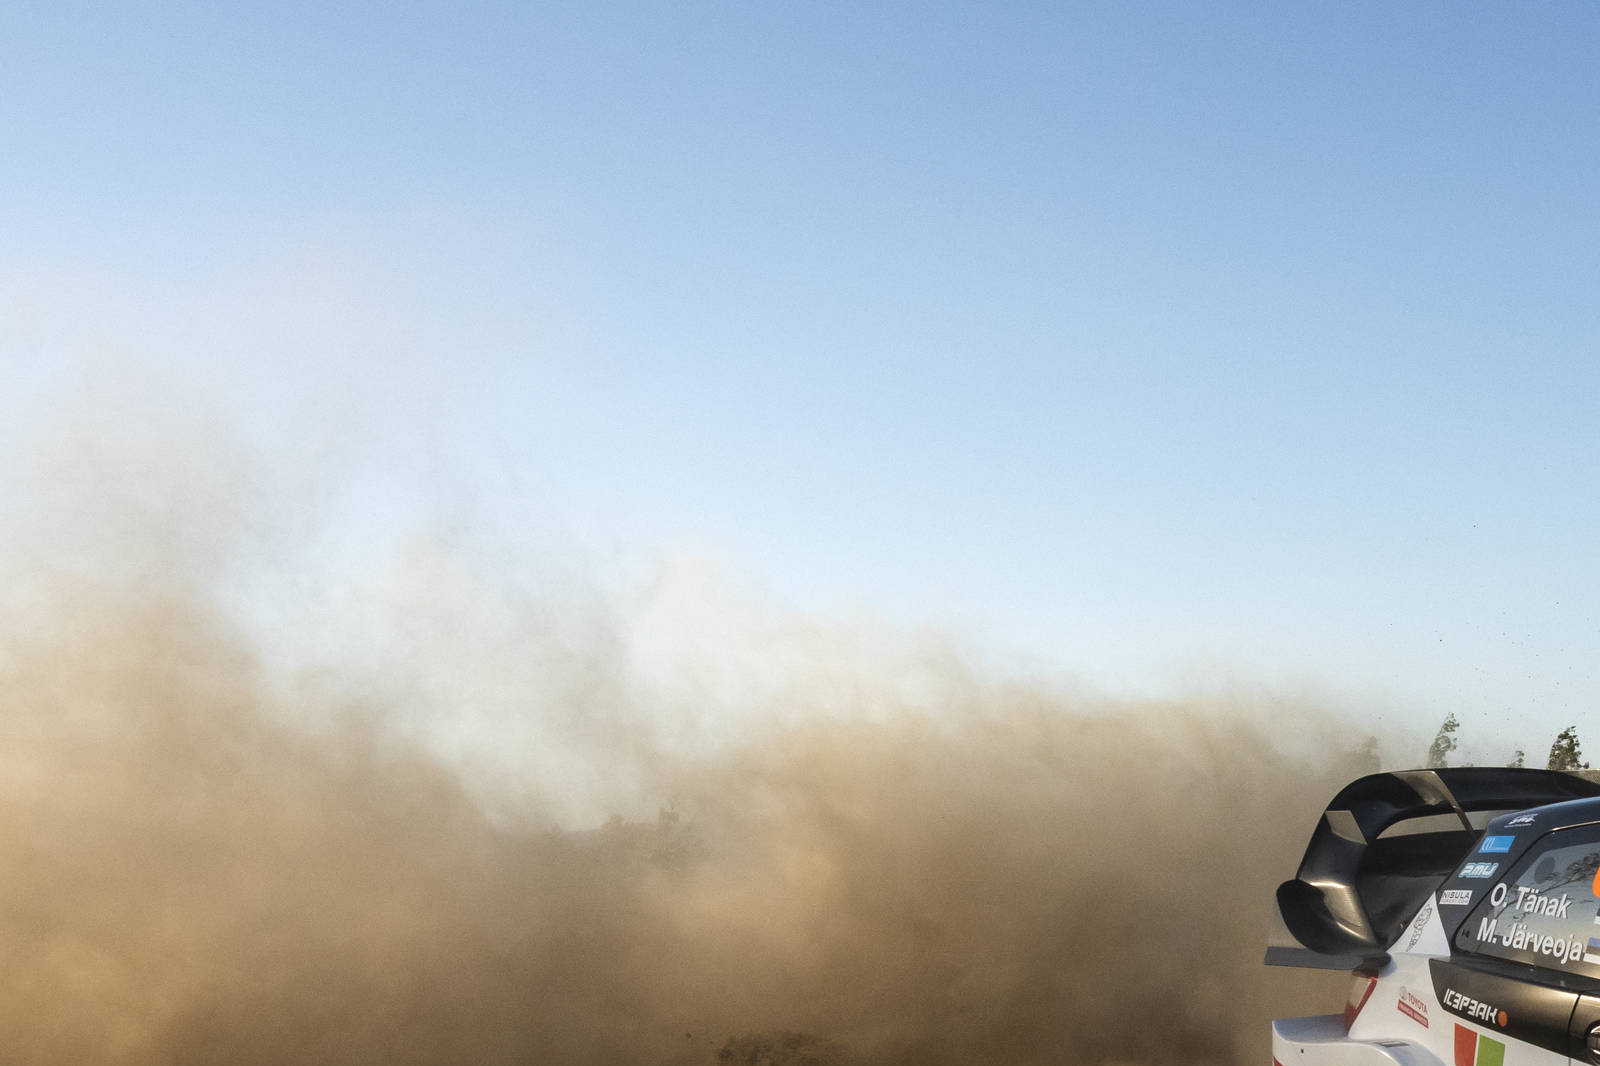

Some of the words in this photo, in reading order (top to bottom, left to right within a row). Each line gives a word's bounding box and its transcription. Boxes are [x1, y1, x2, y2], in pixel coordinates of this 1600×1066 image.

[1490, 882, 1507, 908] O.
[1515, 886, 1573, 919] Tänak
[1476, 917, 1498, 944] M.
[1503, 922, 1585, 965] Järveoja
[1443, 988, 1498, 1024] ICEPEAK
